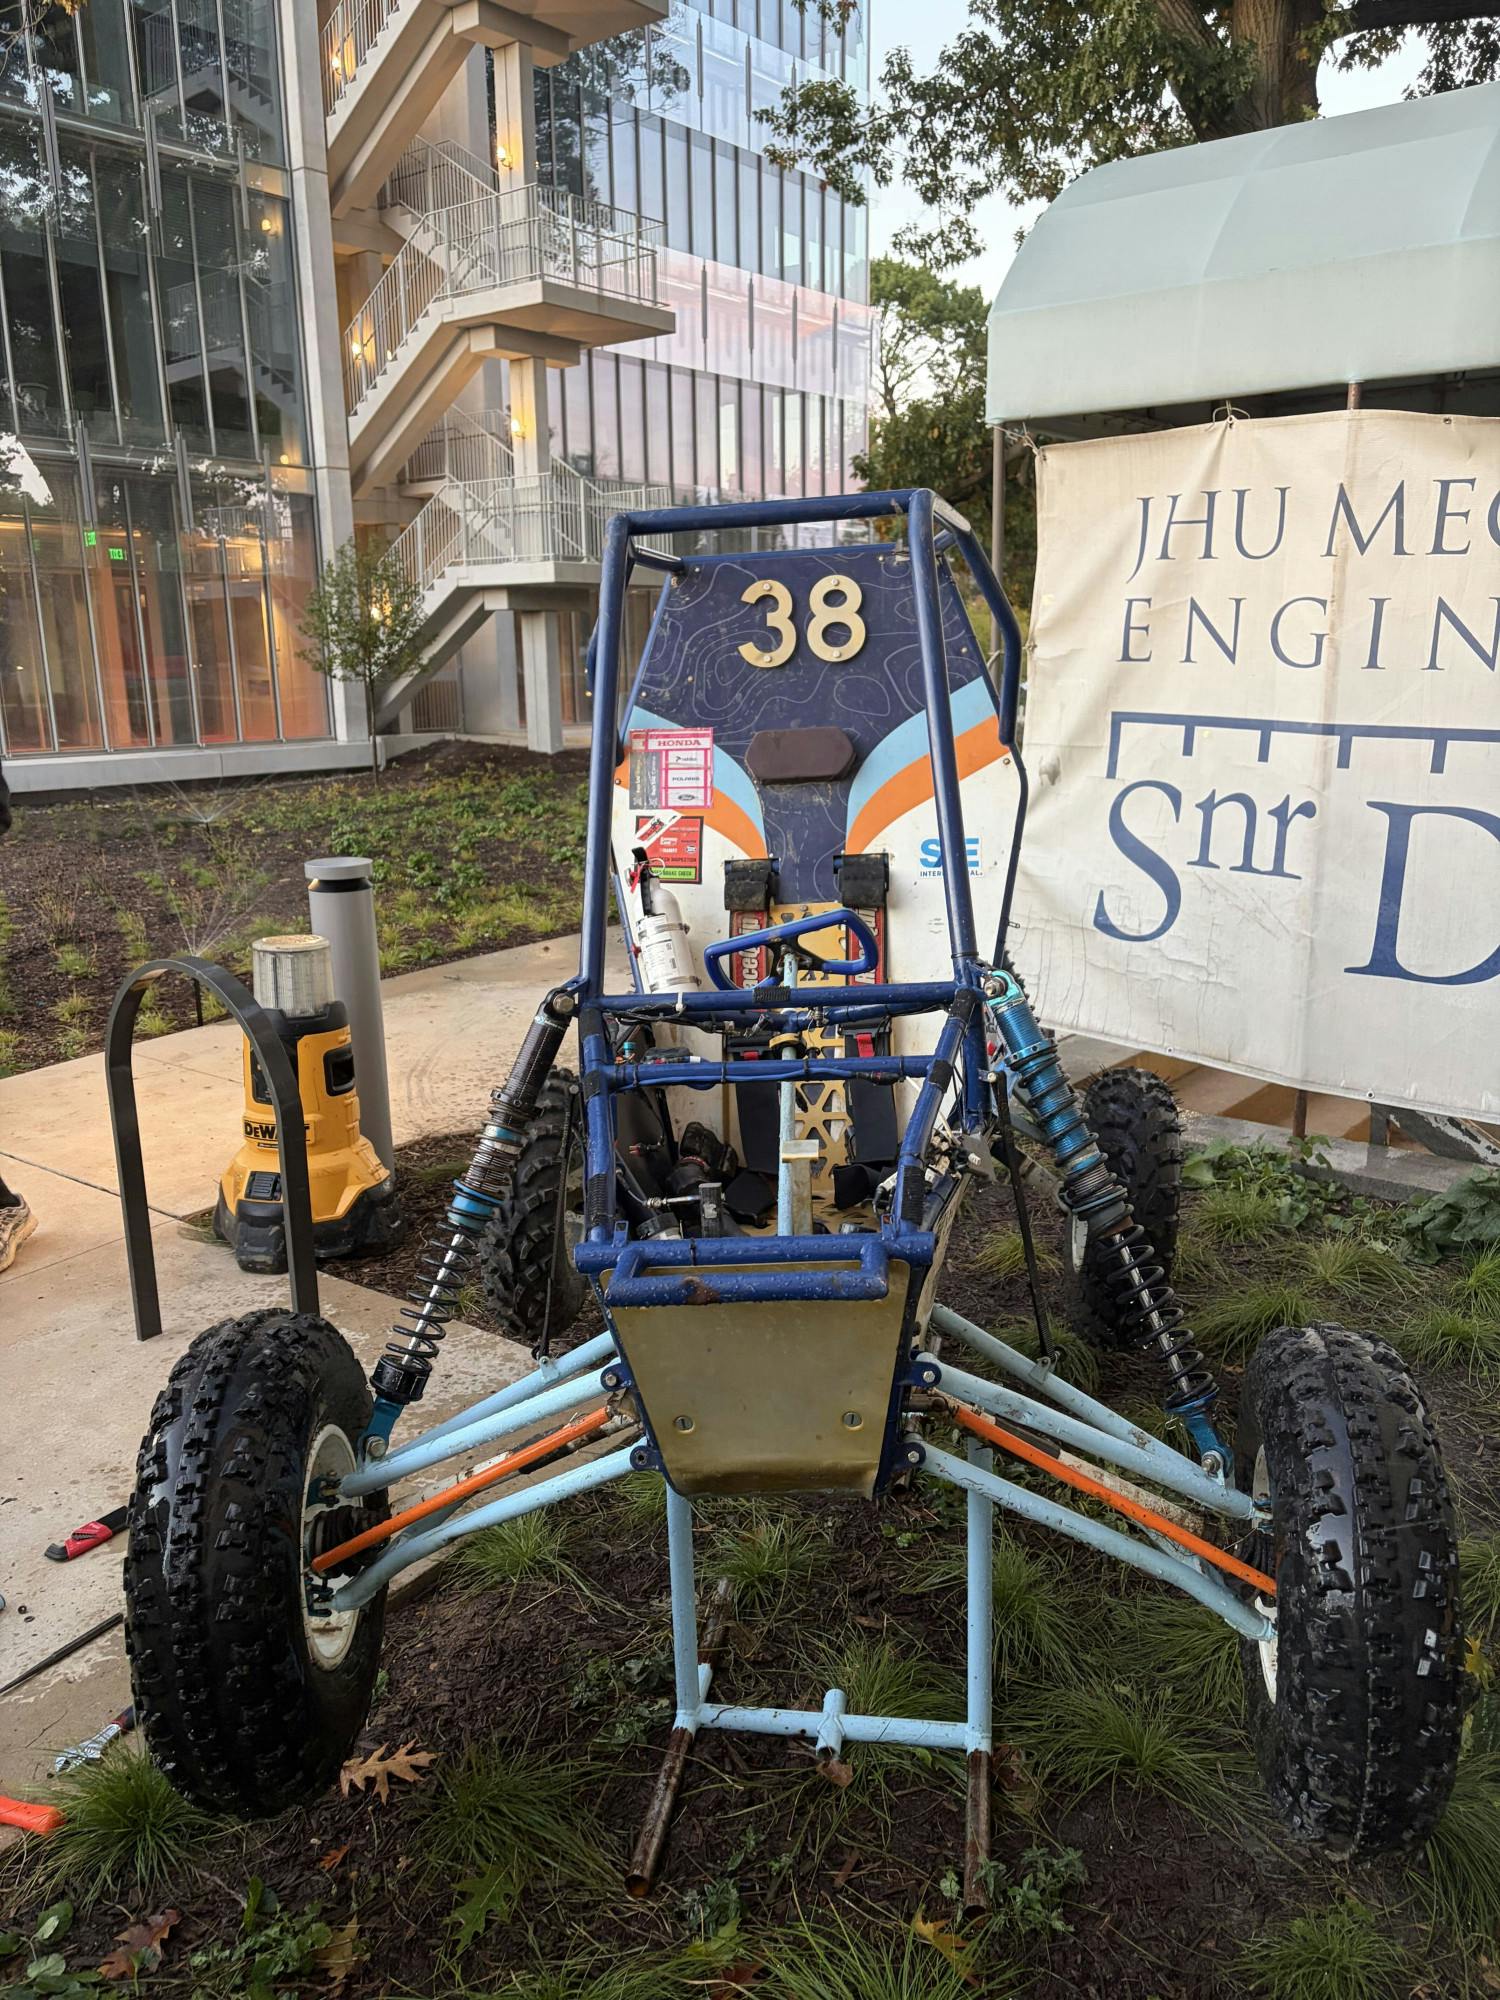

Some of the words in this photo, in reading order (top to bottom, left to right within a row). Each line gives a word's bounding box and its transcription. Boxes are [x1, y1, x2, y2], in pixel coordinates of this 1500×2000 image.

[1125, 486, 1292, 584] JHU
[1320, 477, 1500, 557] ME
[737, 574, 866, 668] 38
[1115, 595, 1500, 672] ENGIN
[657, 739, 702, 747] HONDA
[919, 837, 980, 868] SE
[1093, 779, 1317, 943] Snr
[738, 917, 761, 990] aceQip
